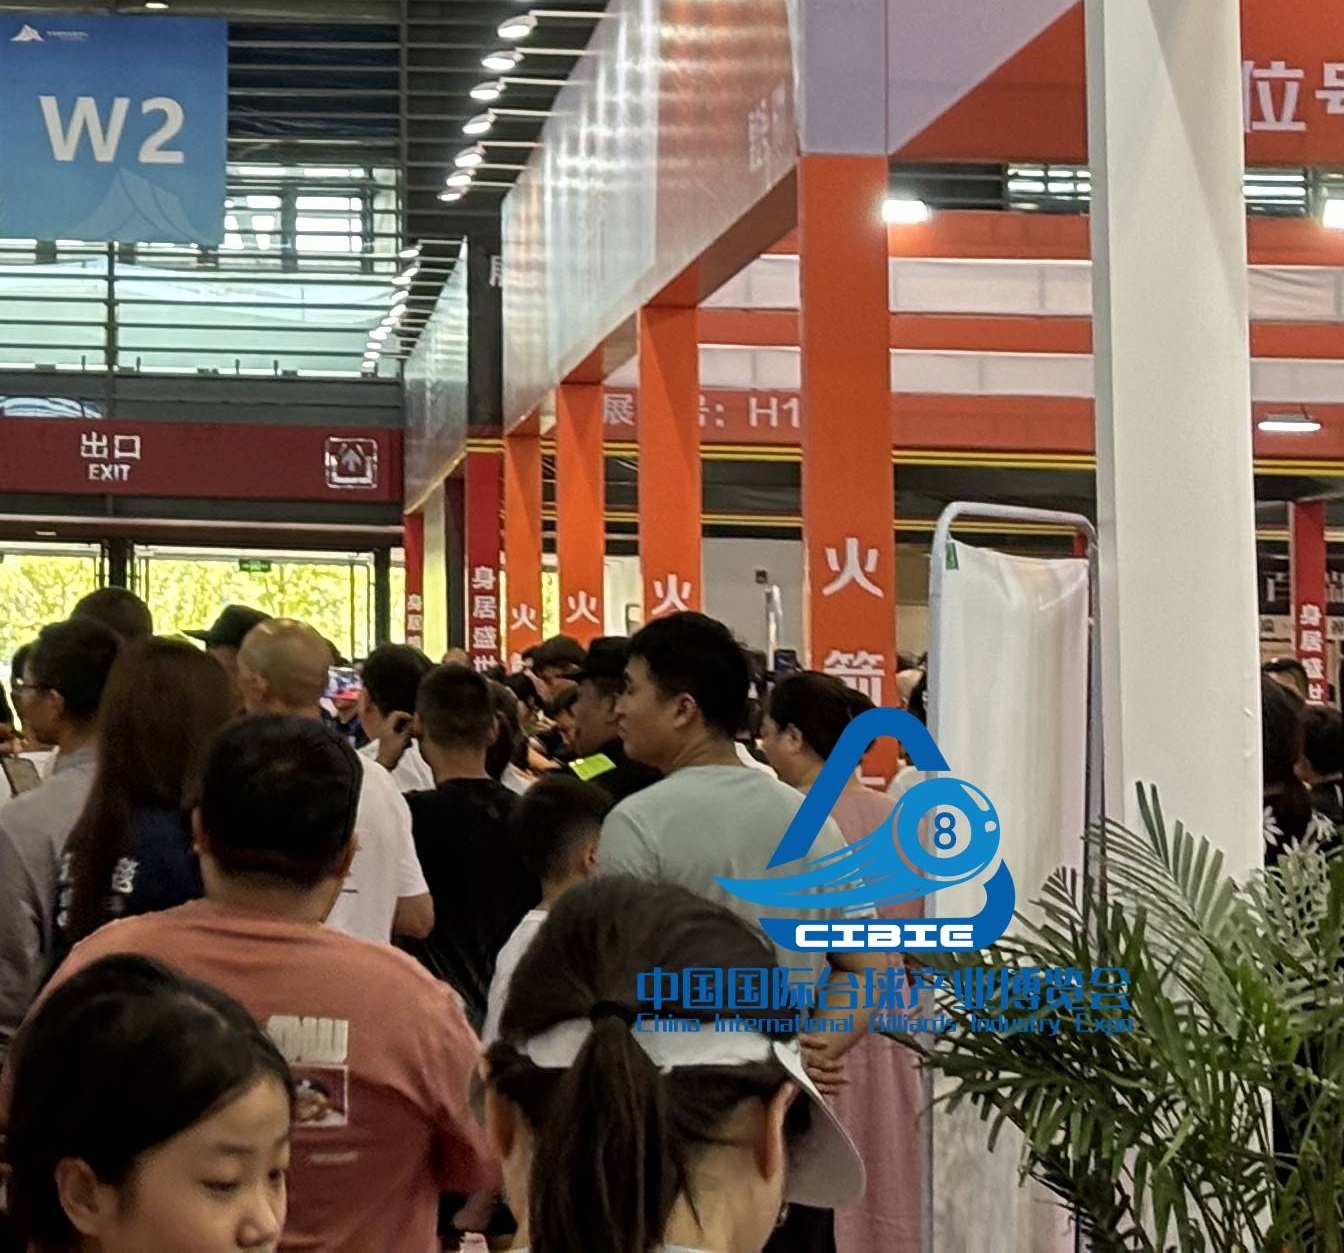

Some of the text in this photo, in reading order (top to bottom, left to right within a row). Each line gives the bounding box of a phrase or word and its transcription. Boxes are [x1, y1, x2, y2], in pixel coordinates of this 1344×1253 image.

[38, 95, 186, 165] W2
[79, 430, 142, 461] 出口
[87, 462, 133, 482] EXIT
[566, 590, 600, 624] 火
[649, 573, 692, 616] 火
